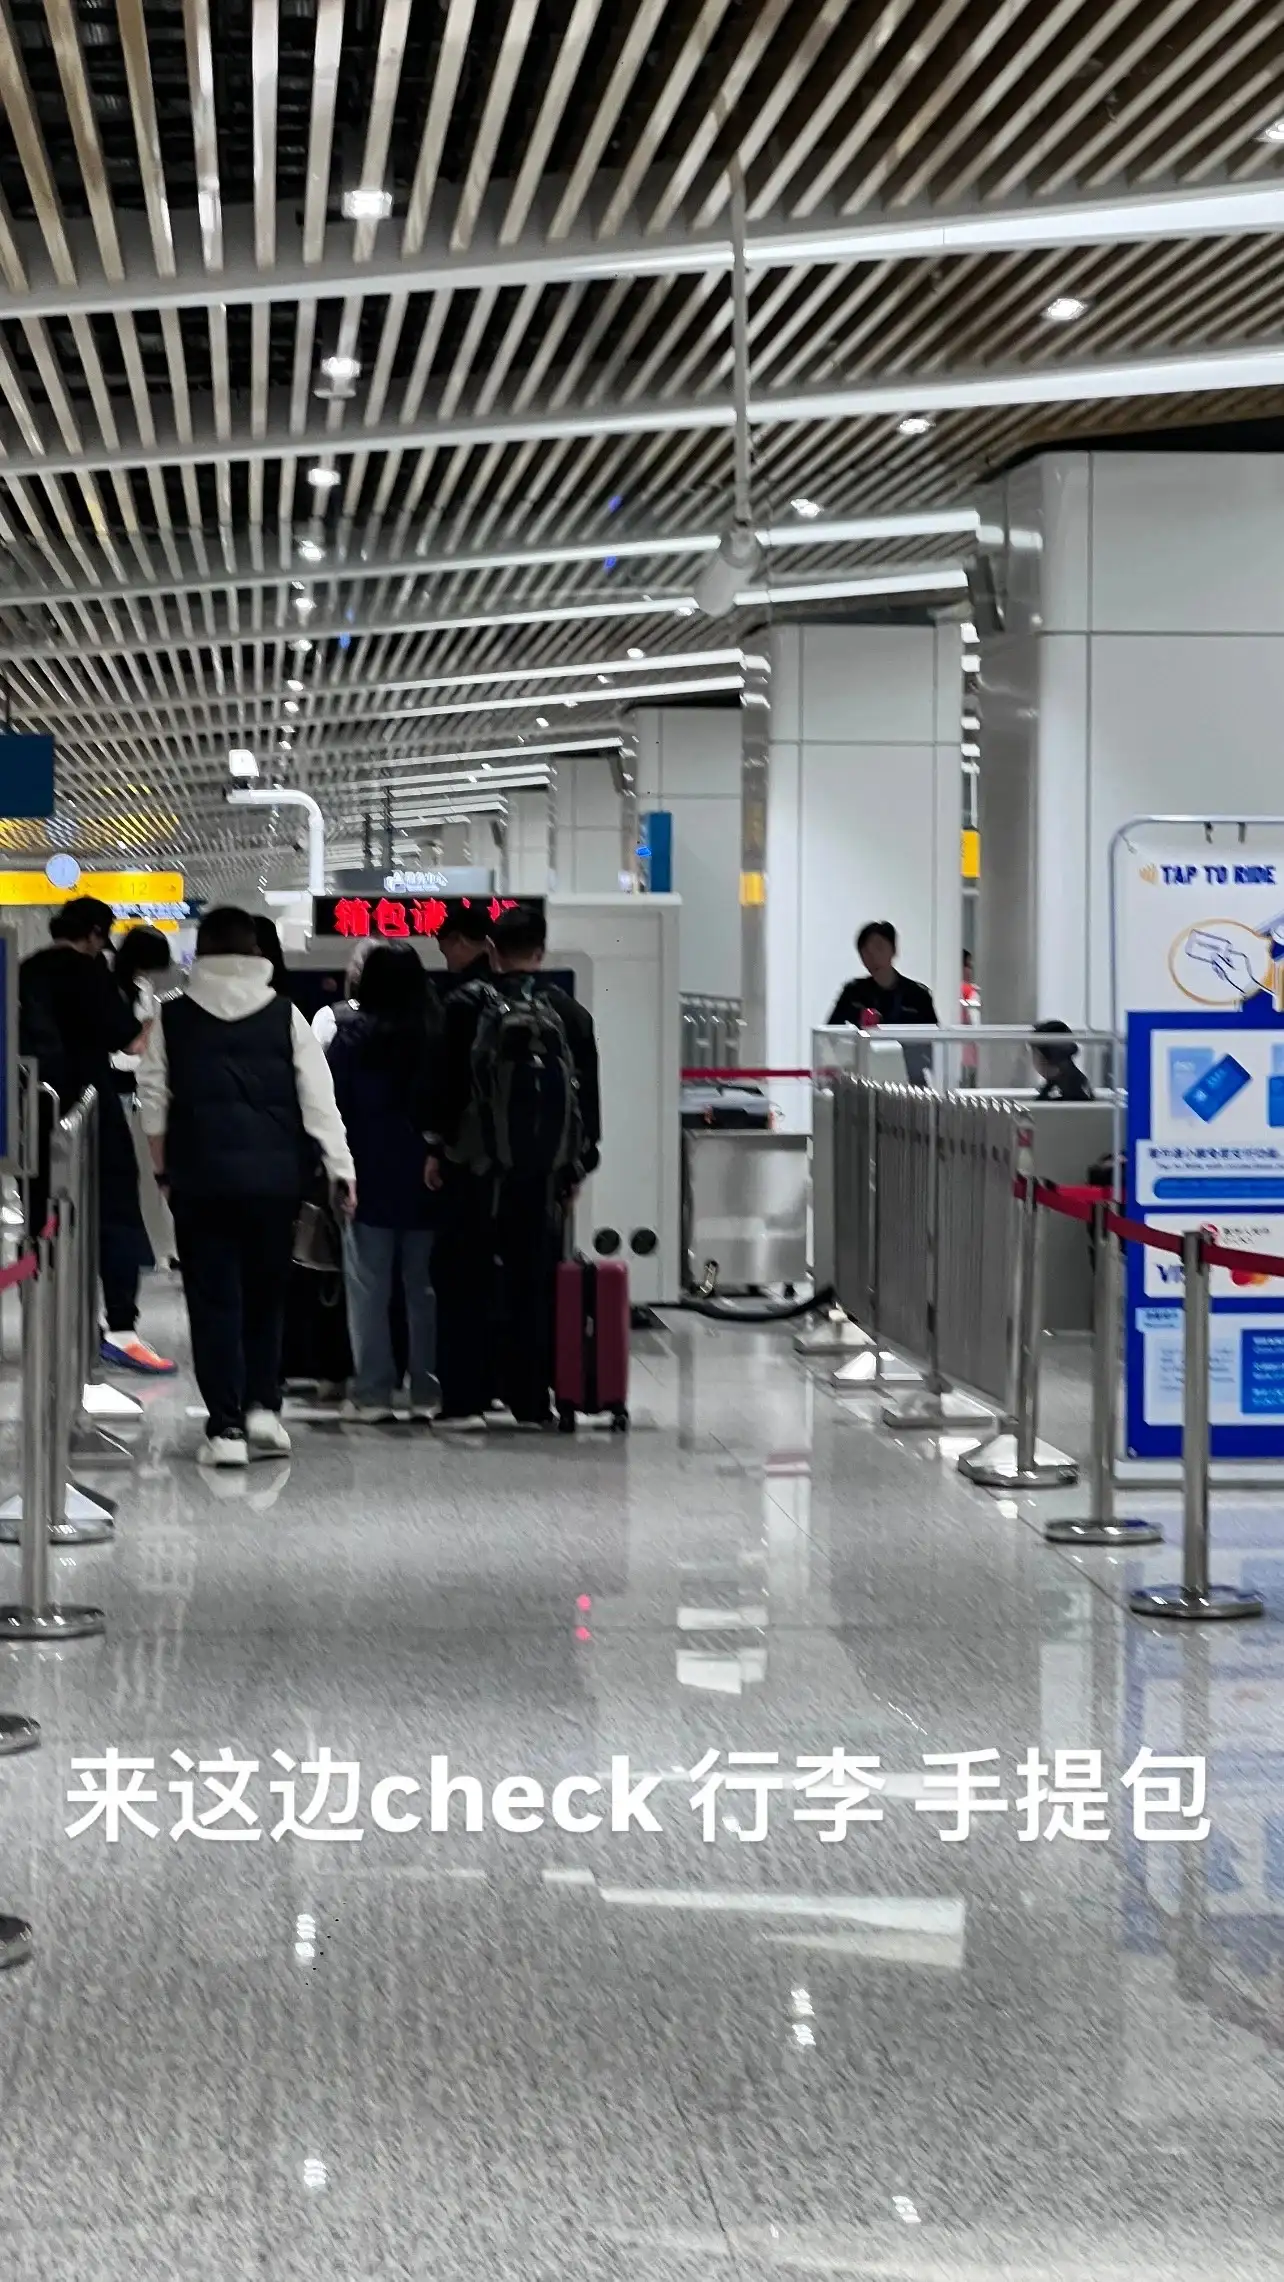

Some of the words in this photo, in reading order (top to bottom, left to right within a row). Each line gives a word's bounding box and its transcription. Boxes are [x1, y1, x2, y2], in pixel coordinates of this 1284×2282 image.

[1160, 864, 1198, 885] TAP
[1203, 864, 1228, 885] TO
[1233, 864, 1277, 885] RIDE
